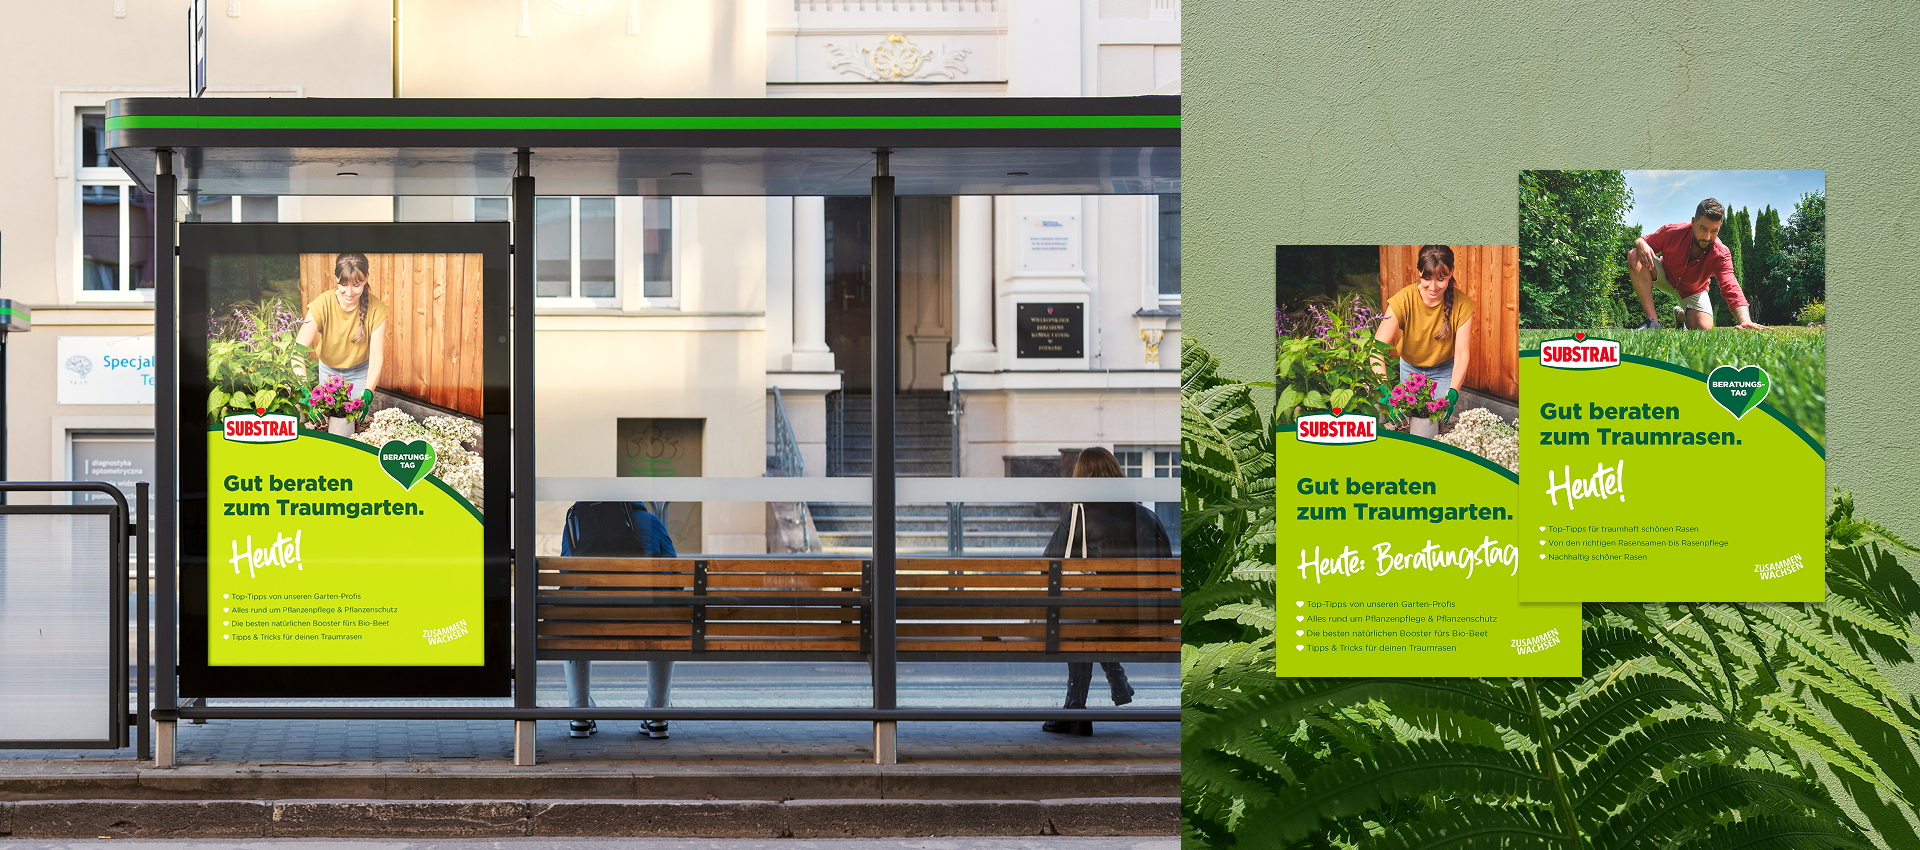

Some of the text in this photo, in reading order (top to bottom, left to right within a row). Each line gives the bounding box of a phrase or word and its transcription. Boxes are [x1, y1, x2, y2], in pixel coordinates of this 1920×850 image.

[103, 355, 155, 370] Specjal
[140, 373, 155, 386] Te
[1730, 389, 1747, 397] TAG
[1540, 402, 1679, 420] Gut beraten
[1540, 428, 1742, 445] zum Traumrasen.
[91, 459, 132, 468] diagnostyka
[382, 453, 433, 461] BERATUNGS-
[399, 461, 416, 469] TAG
[91, 468, 143, 476] optometryczna
[224, 475, 353, 492] Gut beraten
[1297, 477, 1436, 495] Gut beraten
[1546, 460, 1625, 510] Heute!
[224, 499, 424, 519] zum Traumgarten.
[1297, 503, 1513, 523] zum Traumgarten.
[1548, 525, 1699, 534] Top-Tipps für traumhaft schönen Rasen
[1548, 539, 1729, 548] Von den richtigen Rasensamen bis Rasenpflege
[229, 530, 303, 578] Heute!
[1297, 536, 1518, 584] Heute: Beratungstag
[1548, 553, 1648, 562] Nachhaltig schöner Rasen
[1754, 552, 1802, 573] ZUSAMMEN
[1760, 560, 1804, 580] WACHSEN
[231, 592, 268, 601] Top-Tipps
[313, 592, 362, 600] Garten-Profis
[231, 606, 249, 614] Alles
[250, 606, 268, 614] rund
[282, 606, 336, 615] Pflanzenpflege
[344, 605, 398, 614] Pflanzenschutz
[1306, 600, 1347, 609] Top-Tipps
[1400, 600, 1456, 608] Garten-Profis
[231, 619, 390, 628] Die besten natürlichen Booster fürs Bio-Beet
[1306, 614, 1327, 623] Alles
[1328, 614, 1348, 623] rund
[1365, 614, 1426, 624] Pflanzenpflege
[1436, 614, 1498, 623] Pflanzenschutz
[422, 618, 467, 638] ZUSAMMEN
[1306, 629, 1488, 638] Die besten natürlichen Booster fürs Bio-Beet
[231, 633, 252, 642] Tipps
[260, 633, 282, 641] Tricks
[282, 633, 294, 641] für
[294, 633, 319, 641] deinen
[320, 633, 363, 641] Traumrasen
[427, 626, 469, 645] WACHSEN
[1510, 627, 1559, 648] ZUSAMMEN
[1306, 644, 1330, 653] Tipps
[1339, 644, 1364, 652] Tricks
[1365, 643, 1378, 652] für
[1378, 643, 1407, 652] deinen
[1408, 644, 1457, 652] Traumrasen
[1516, 635, 1560, 655] WACHSEN
